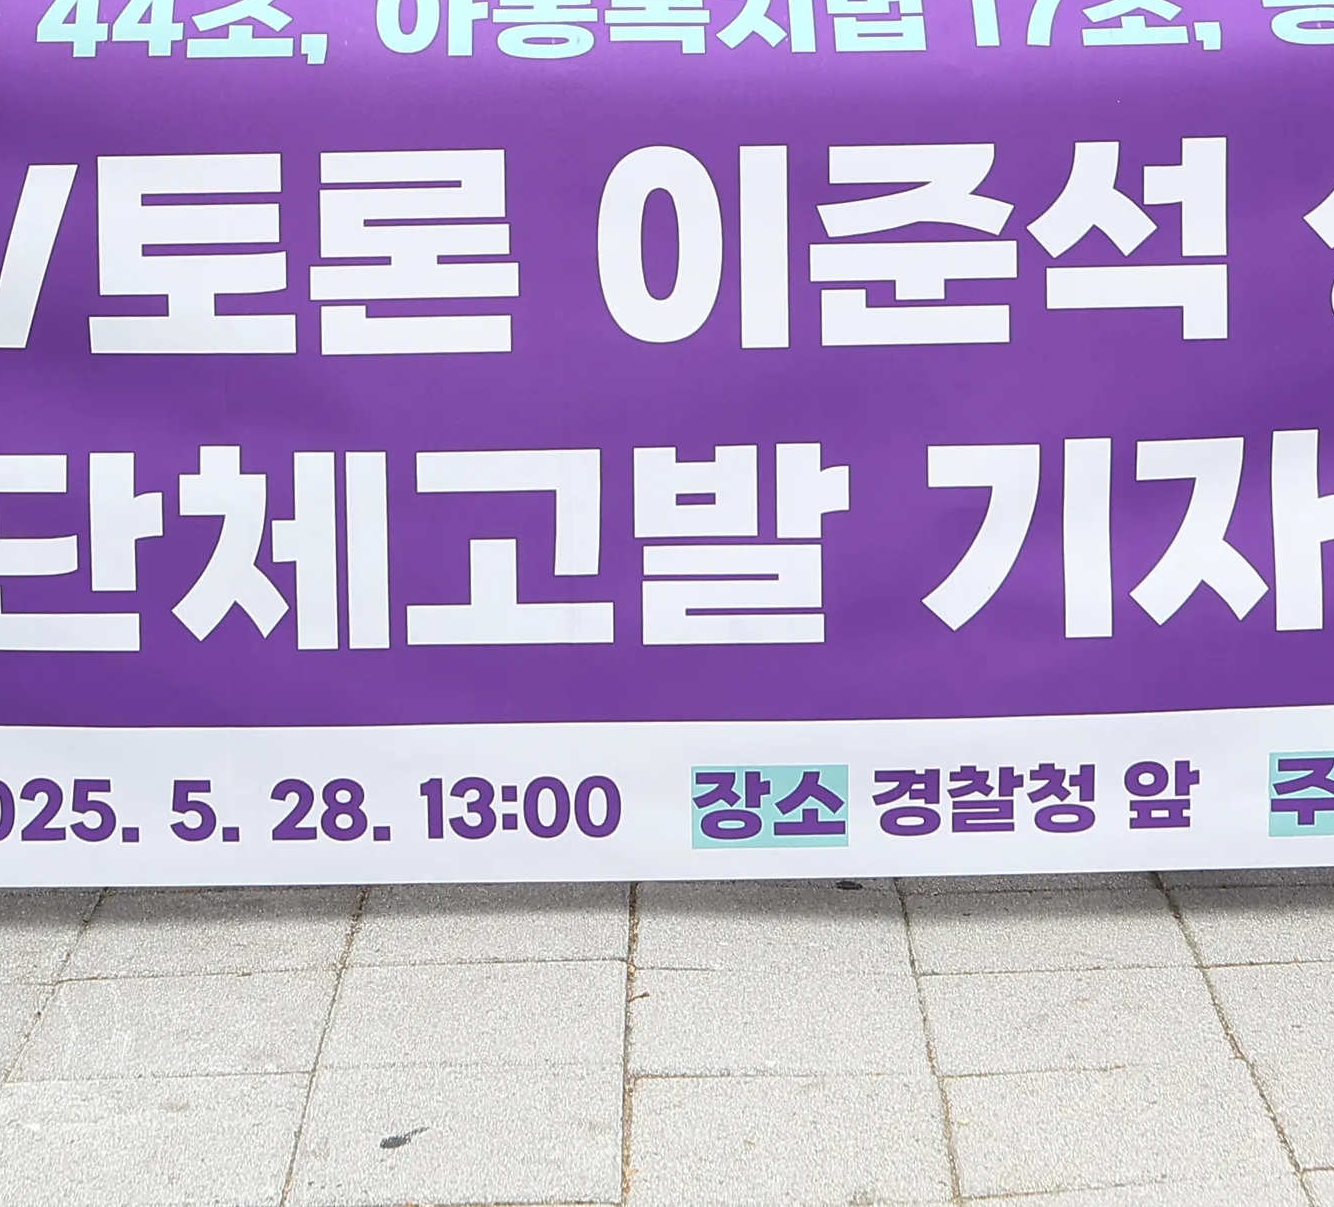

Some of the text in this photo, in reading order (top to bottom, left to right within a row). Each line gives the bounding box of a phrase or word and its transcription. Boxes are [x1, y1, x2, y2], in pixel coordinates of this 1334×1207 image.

[597, 136, 1228, 349] 이준석
[169, 778, 241, 842] 5.
[270, 776, 391, 842] 28.
[421, 775, 623, 840] 13:00
[692, 769, 847, 840] 장소
[870, 762, 1097, 836] 경찰청
[1124, 759, 1200, 829] 앞
